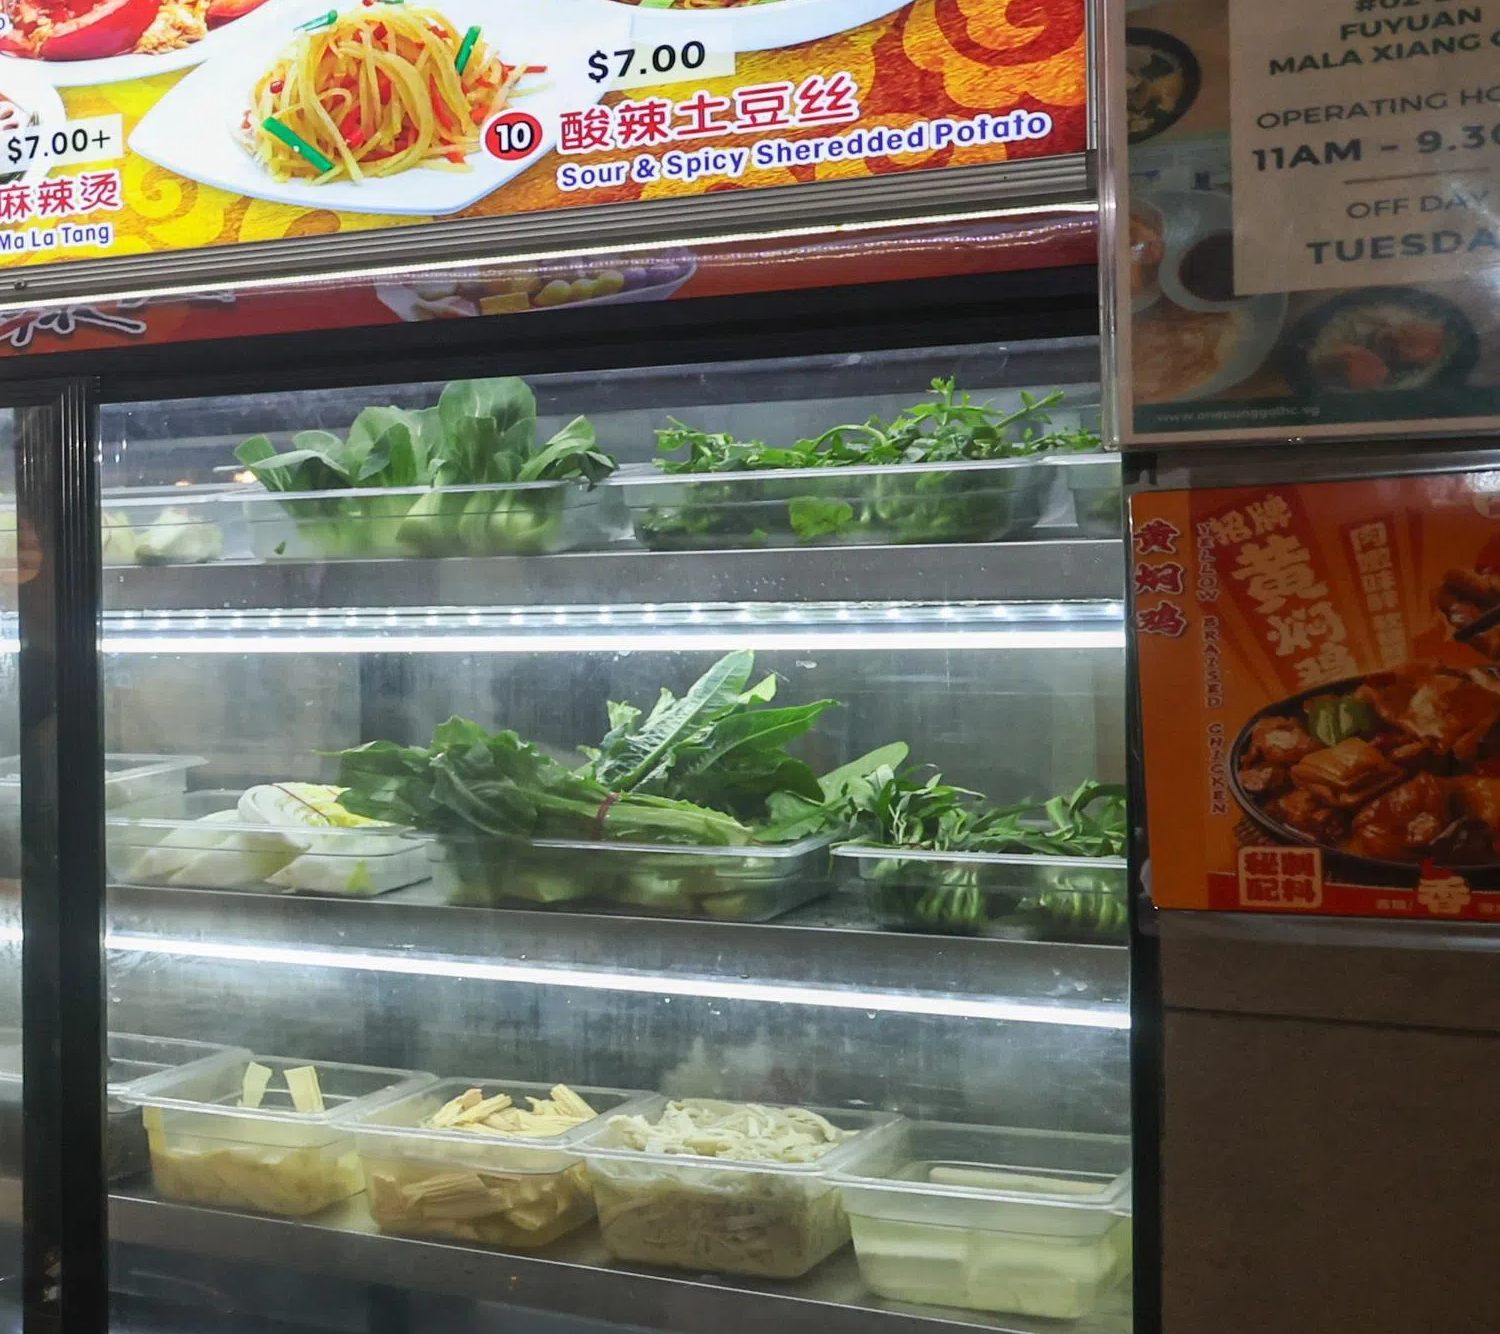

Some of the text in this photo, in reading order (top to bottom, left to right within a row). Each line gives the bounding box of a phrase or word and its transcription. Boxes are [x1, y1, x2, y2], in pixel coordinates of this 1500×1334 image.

[1339, 6, 1482, 42] FUYUAN
[587, 40, 708, 84] $7.00
[1268, 48, 1363, 76] MALA
[1371, 32, 1481, 64] XIANG
[494, 72, 860, 156] 10 酸辣土豆丝
[1256, 91, 1448, 129] OPERATING
[6, 130, 113, 166] $7.00+
[557, 108, 1051, 190] Sour & Spicy Sheredded Potato
[1252, 137, 1363, 172] 11AM
[1346, 188, 1491, 220] OFF DAY
[31, 225, 57, 250] La
[60, 221, 111, 251] Tang
